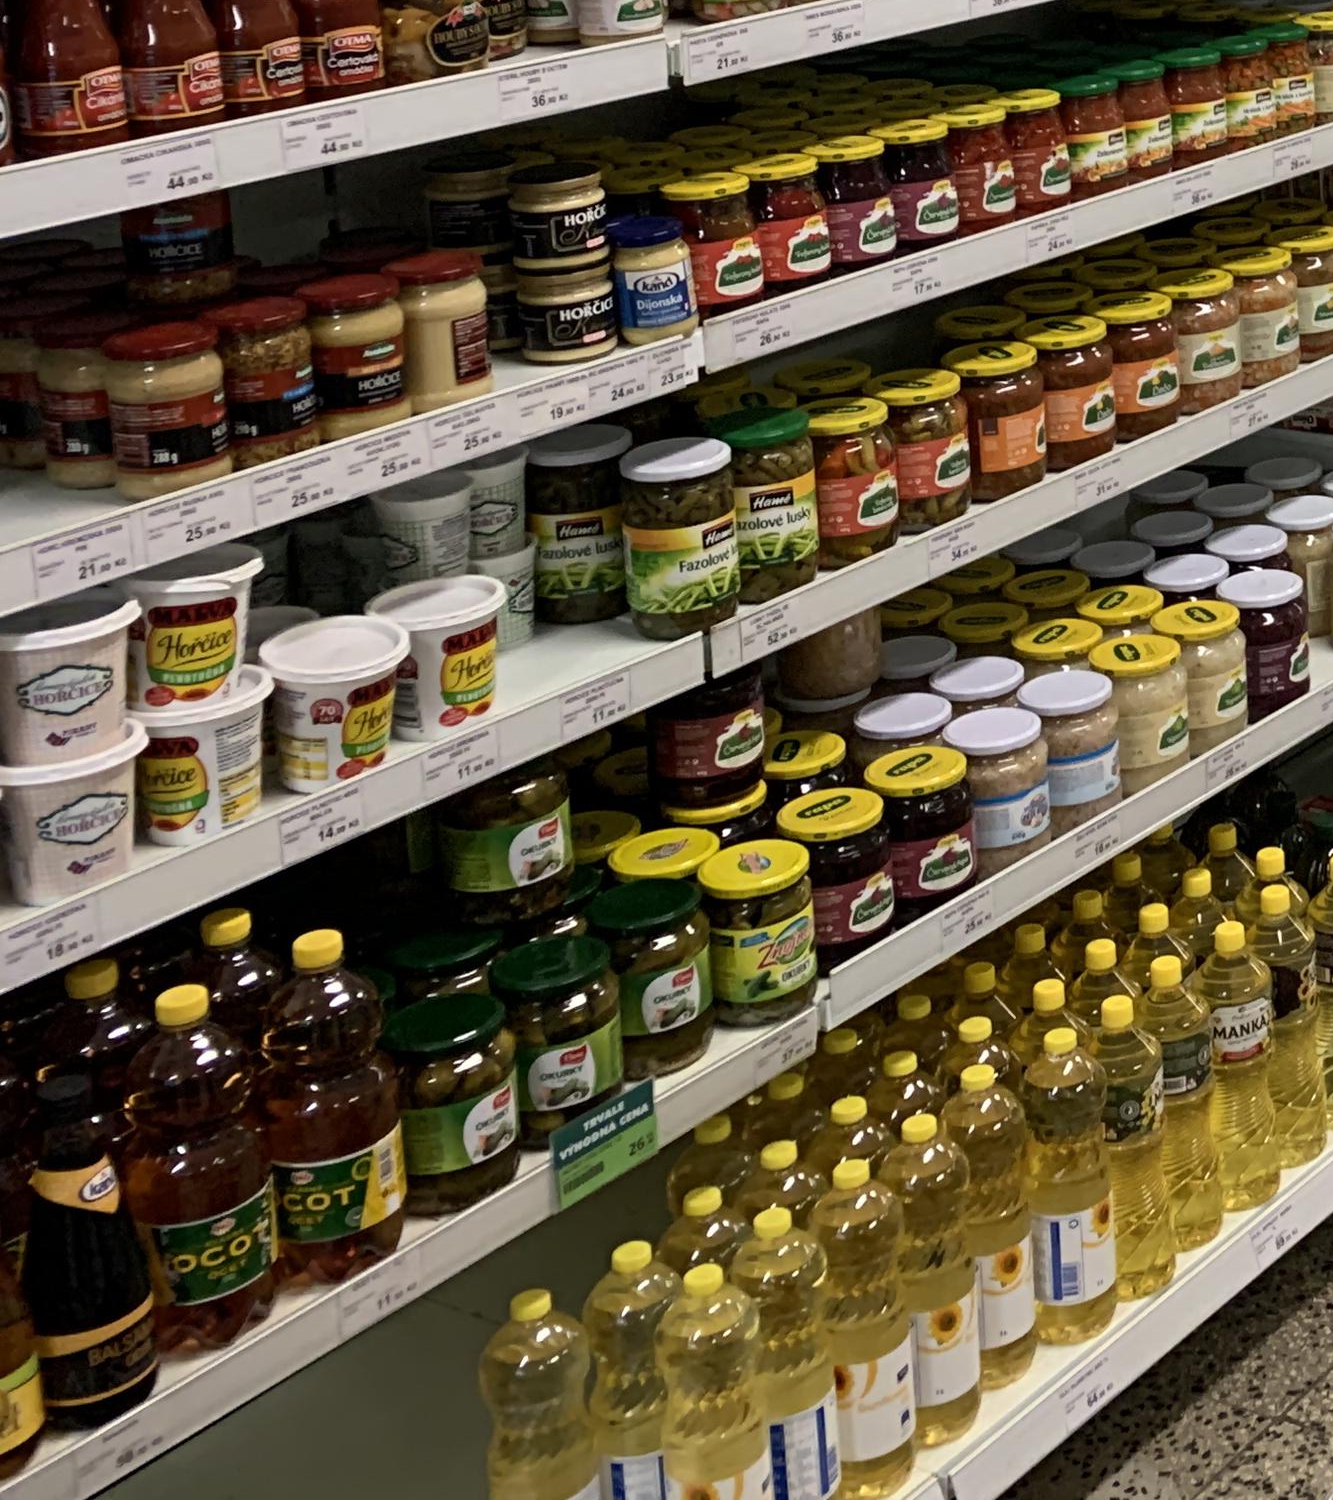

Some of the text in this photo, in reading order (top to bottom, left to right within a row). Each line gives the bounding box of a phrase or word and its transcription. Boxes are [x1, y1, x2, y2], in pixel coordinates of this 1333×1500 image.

[334, 33, 372, 47] OTMA
[642, 278, 673, 292] kand
[637, 294, 683, 310] Dijonská
[753, 494, 792, 509] Hamé
[678, 550, 731, 575] Fazolové
[157, 629, 234, 663] Hořčice
[318, 705, 337, 717] 70
[540, 1064, 584, 1083] OKURKY
[583, 1101, 625, 1131] TRVALE
[559, 1102, 649, 1161] VÝHODNÁ CENA
